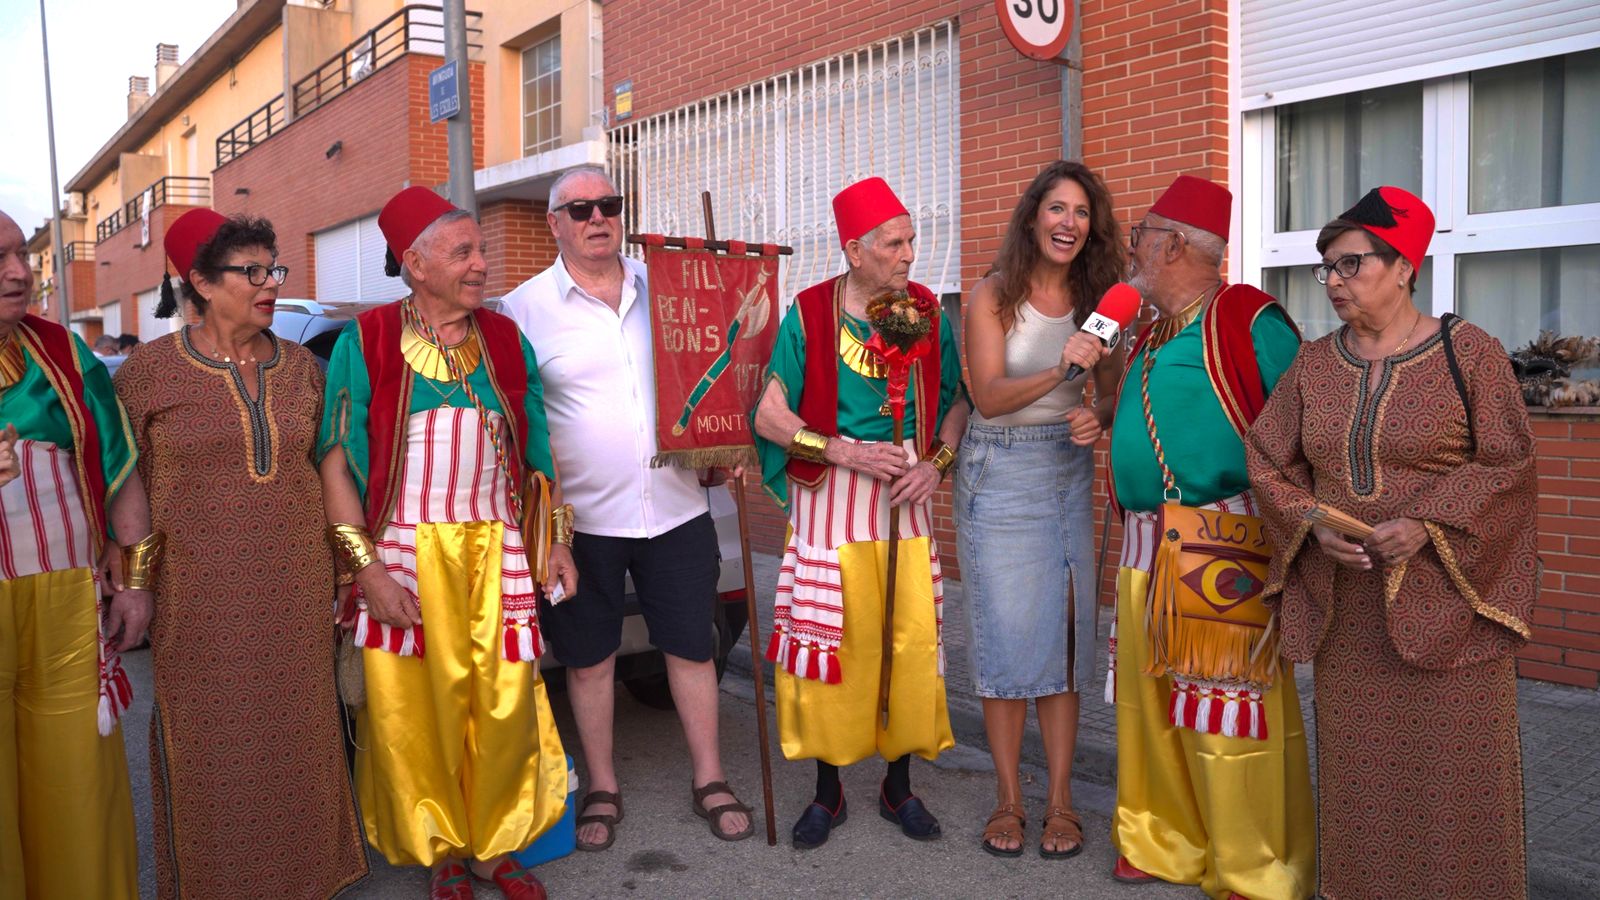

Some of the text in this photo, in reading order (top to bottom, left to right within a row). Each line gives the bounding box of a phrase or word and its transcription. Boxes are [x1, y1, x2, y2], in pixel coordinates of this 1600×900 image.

[1013, 0, 1058, 24] 30
[657, 295, 709, 324] BEN-
[662, 324, 720, 354] BONS
